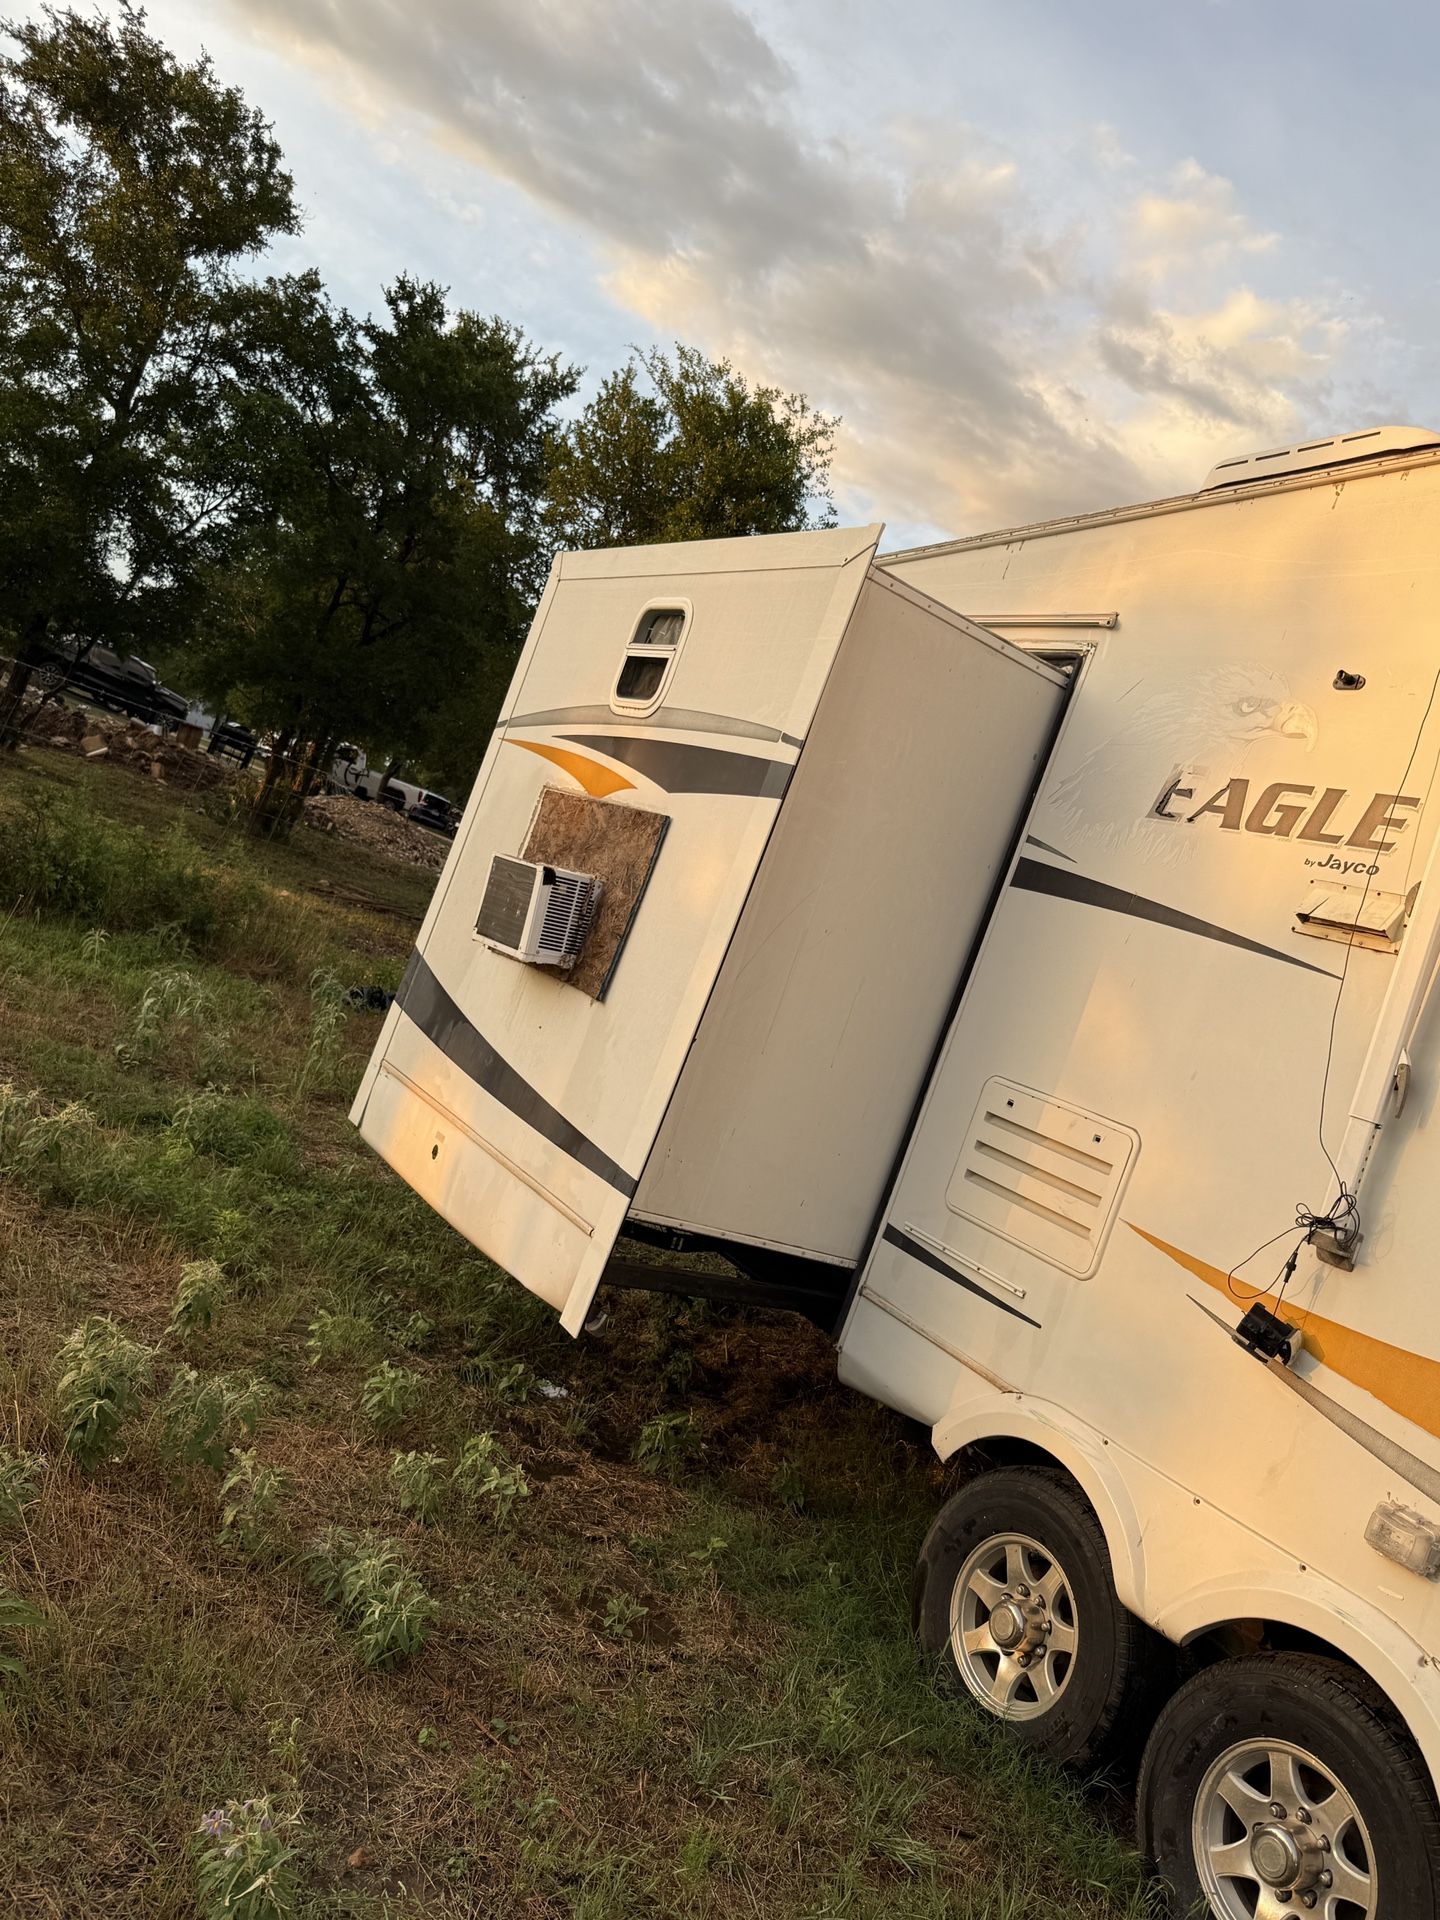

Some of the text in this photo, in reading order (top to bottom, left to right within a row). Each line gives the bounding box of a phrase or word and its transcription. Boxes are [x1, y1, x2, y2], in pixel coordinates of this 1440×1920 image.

[1145, 765, 1421, 853] EAGLE
[1304, 853, 1380, 876] by Jayco
